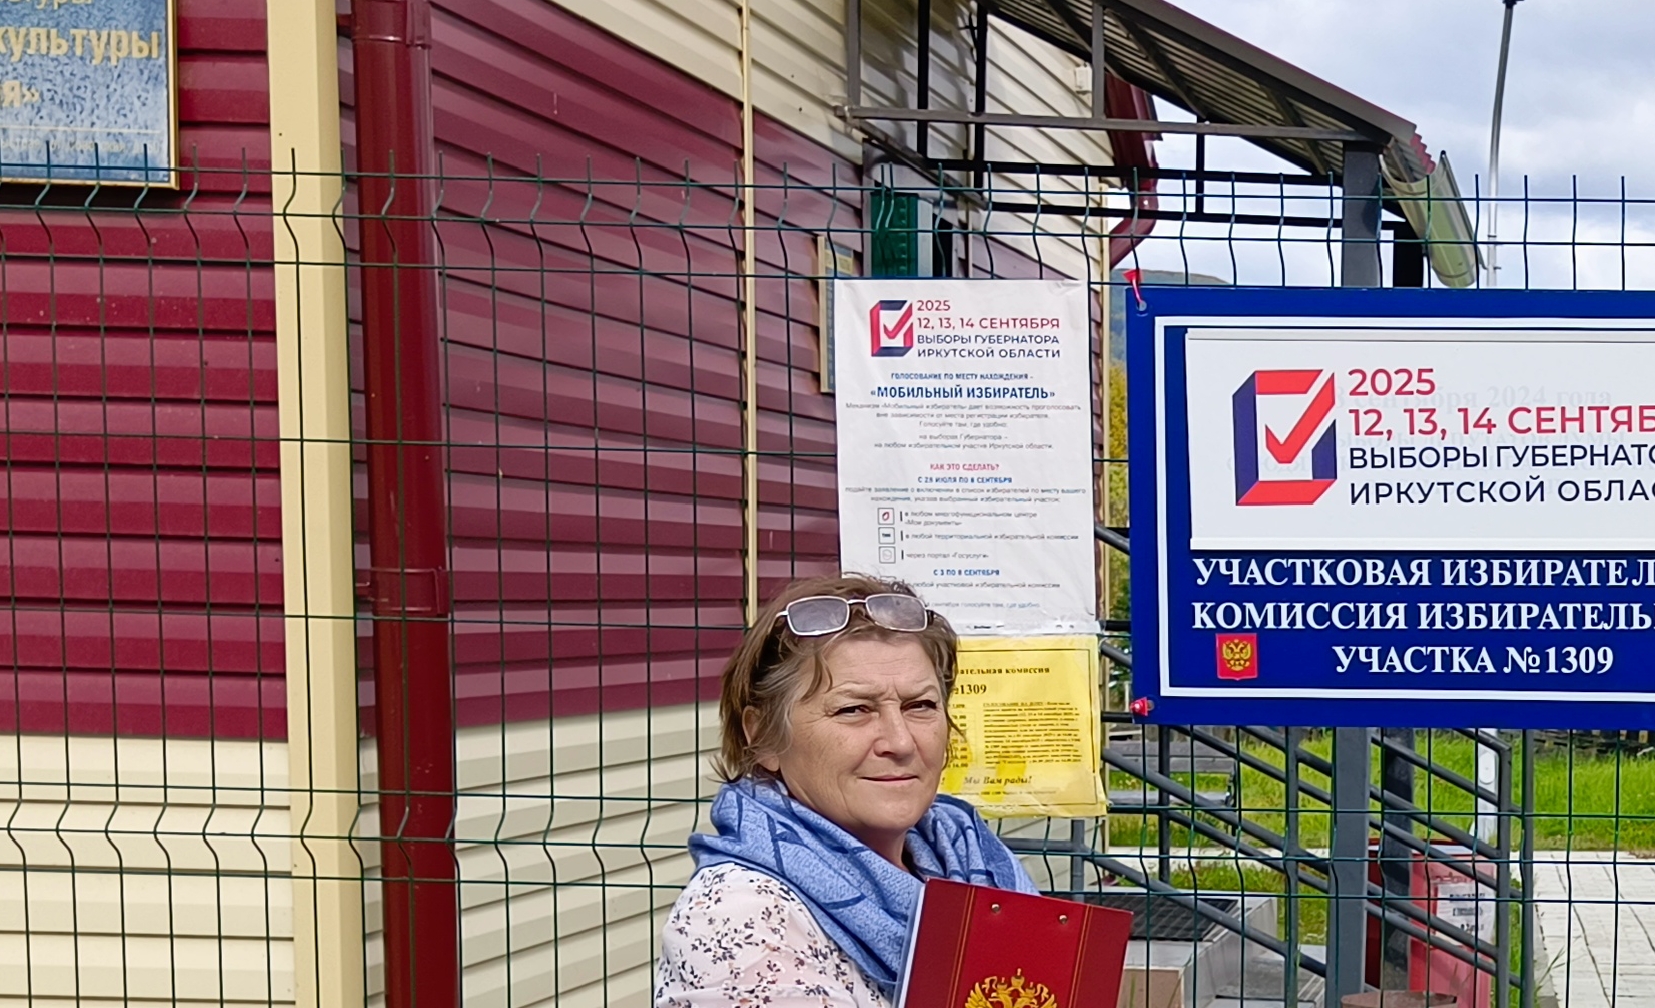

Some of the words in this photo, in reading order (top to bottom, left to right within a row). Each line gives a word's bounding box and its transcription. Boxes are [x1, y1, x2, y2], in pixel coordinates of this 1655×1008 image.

[917, 299, 950, 312] 2025
[918, 317, 934, 330] 12,
[939, 317, 955, 330] 13,
[960, 317, 974, 329] 14
[979, 317, 1059, 330] СЕНТЯБРЯ
[917, 334, 971, 345] ВЫБОРЫ
[975, 334, 1059, 345] ГУБЕРНАТОРА
[918, 347, 994, 359] ИРКУТСКОЙ
[999, 348, 1060, 359] ОБЛАСТИ
[871, 384, 962, 399] «МОБИЛЬНЫЙ
[967, 386, 1054, 399] ИЗБИРАТЕЛЬ»
[1349, 367, 1435, 397] 2025
[1349, 408, 1392, 442] 12,
[1404, 407, 1446, 442] 13,
[1458, 406, 1496, 435] 14
[1350, 445, 1487, 470] ВЫБОРЫ
[1351, 475, 1544, 505] ИРКУТСКОЙ
[1195, 558, 1431, 586] УЧАСТКОВАЯ
[1193, 602, 1407, 630] КОМИССИЯ
[1334, 645, 1495, 673] УЧАСТКА
[1504, 646, 1613, 674] №1309
